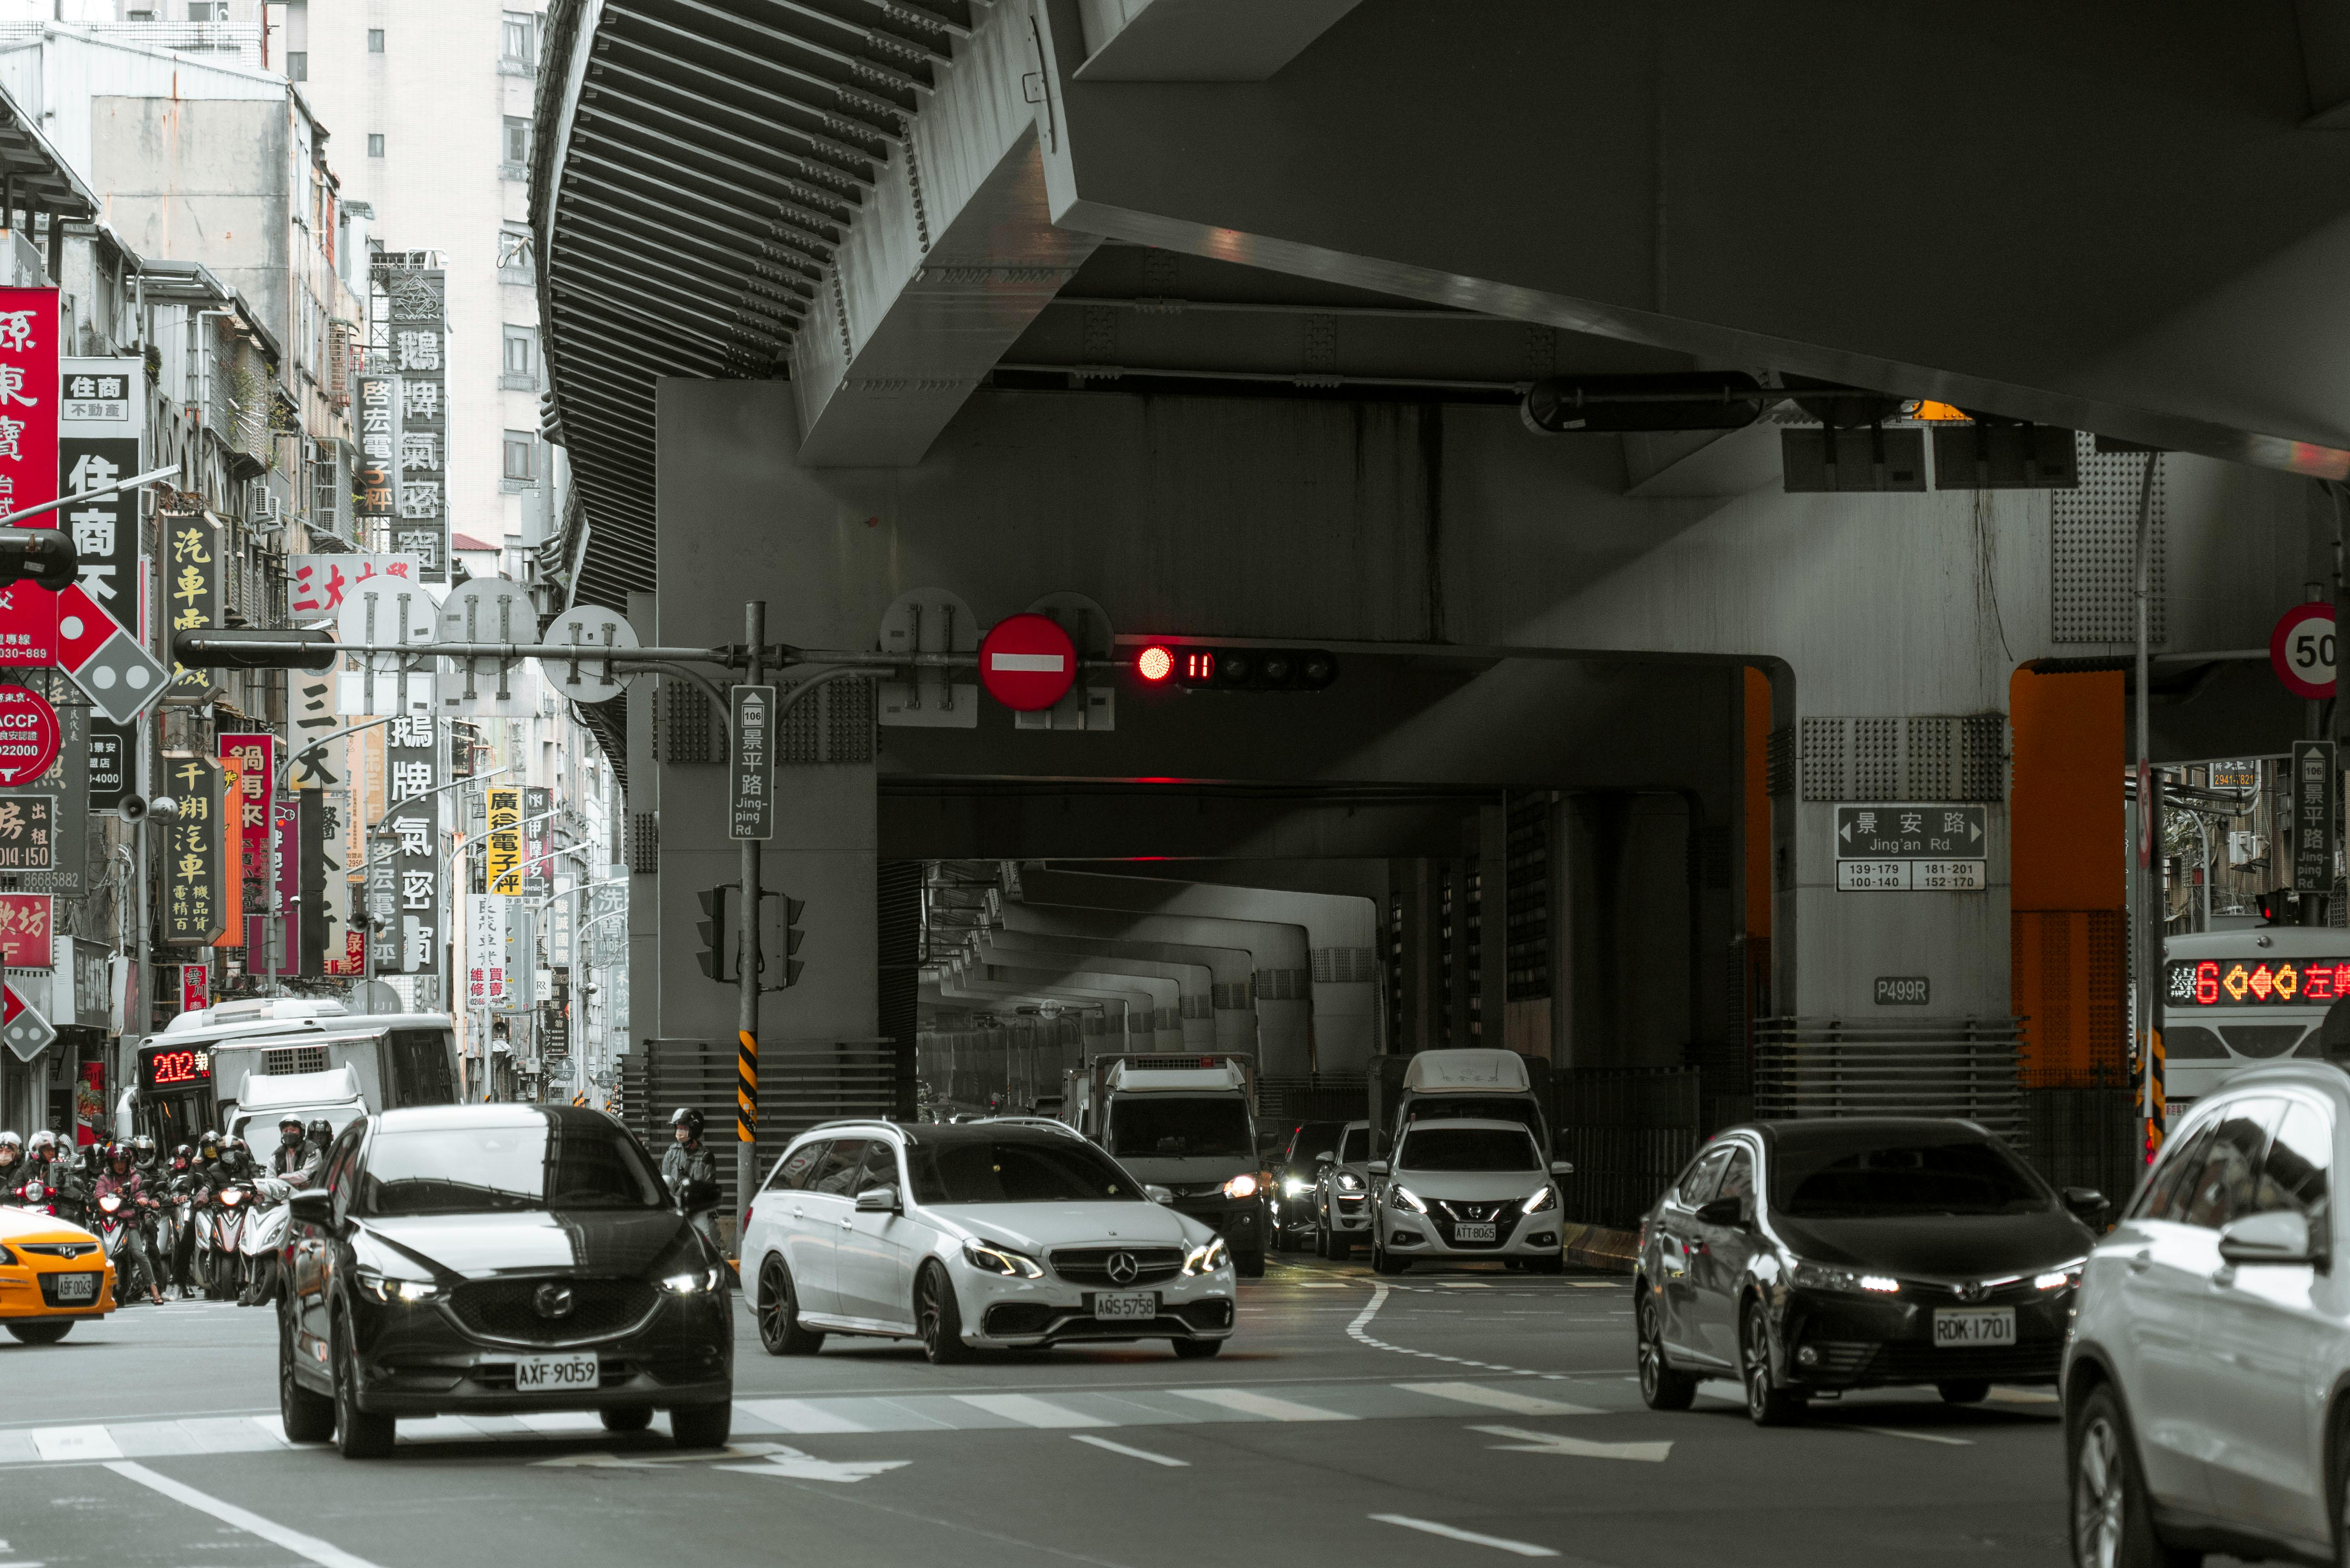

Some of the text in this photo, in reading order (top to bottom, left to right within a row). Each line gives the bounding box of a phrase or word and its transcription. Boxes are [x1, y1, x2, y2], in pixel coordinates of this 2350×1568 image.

[70, 377, 121, 397] 住商
[71, 403, 120, 417] 不動產
[2296, 635, 2336, 668] 50
[1190, 655, 1208, 677] 11
[744, 712, 761, 720] 106
[742, 729, 763, 796] 景平路
[2305, 767, 2323, 775] 106
[736, 798, 768, 810] Jing-
[31, 803, 48, 845] 出租
[175, 762, 208, 885] 千翔汽車
[736, 811, 760, 824] ping
[1857, 812, 1965, 834] 景安路
[2303, 784, 2325, 849] 景平路
[736, 824, 754, 835] Rd.
[491, 792, 519, 892] 廣益電子秤
[1849, 864, 1899, 874] 139-179
[1924, 864, 1973, 874] 181-201
[2298, 866, 2322, 877] ping
[24, 872, 78, 887] 86685882
[1850, 877, 1899, 887] 100-140
[1925, 877, 1974, 887] 152-170
[555, 899, 569, 964] 駿誠國際
[186, 968, 205, 1000] 雲川
[1878, 980, 1926, 1000] P499R
[153, 1050, 196, 1083] 202
